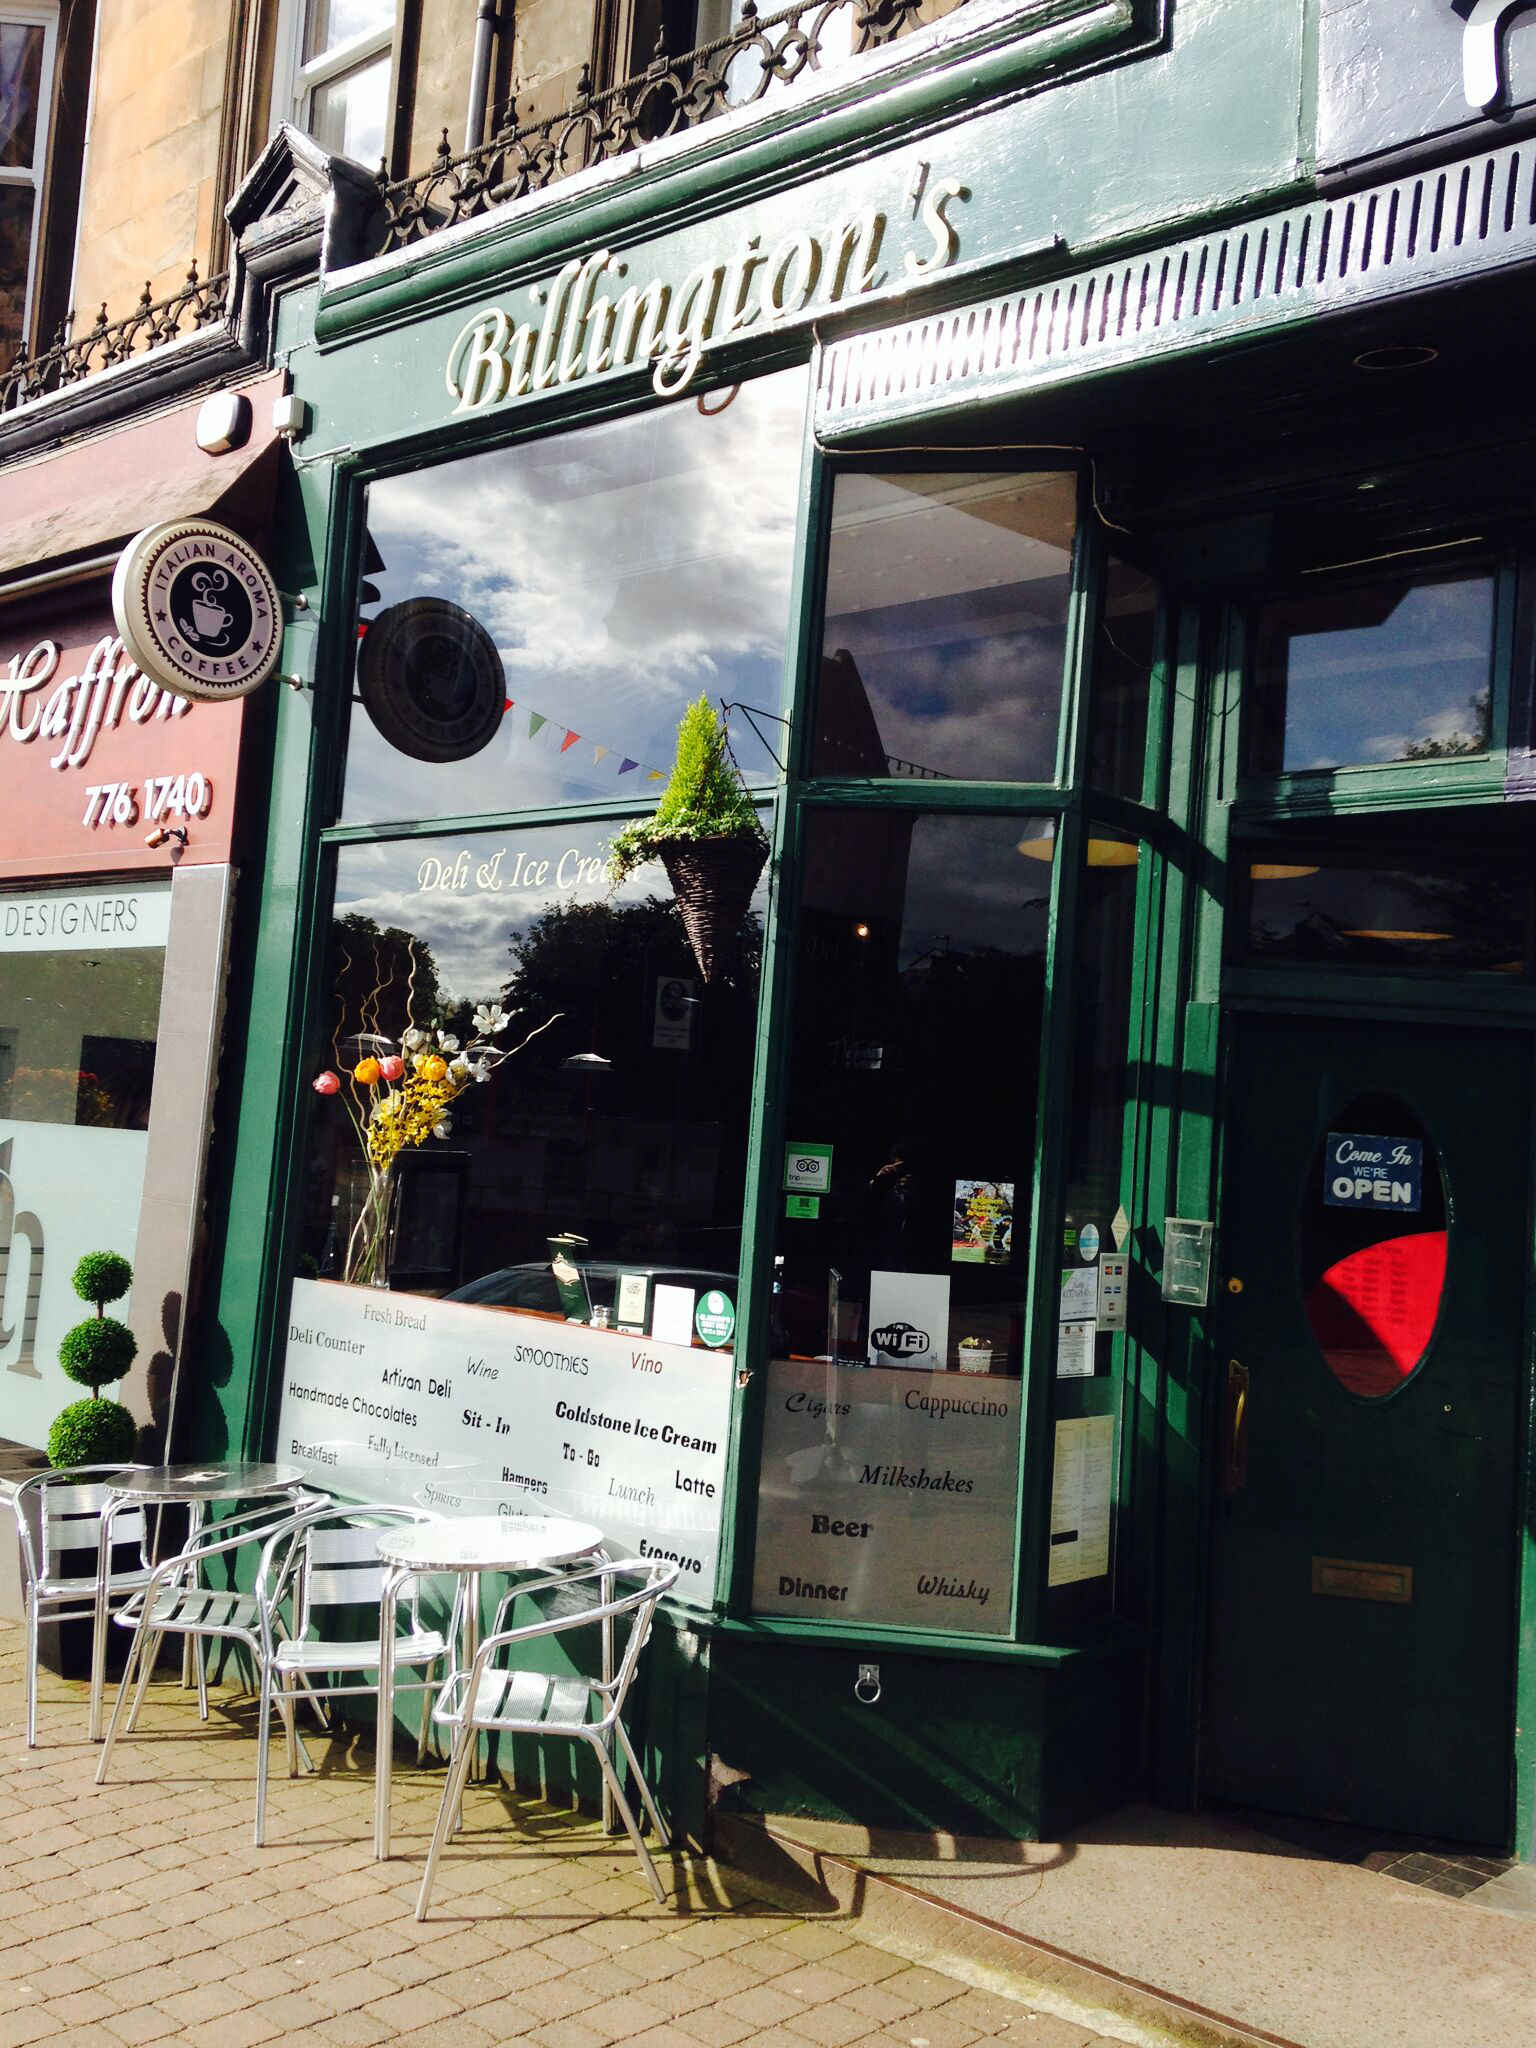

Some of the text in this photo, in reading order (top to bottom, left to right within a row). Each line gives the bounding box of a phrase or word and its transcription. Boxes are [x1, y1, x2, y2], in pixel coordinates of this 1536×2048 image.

[444, 163, 966, 416] Billington's
[155, 543, 268, 619] ITALIAN AROMA
[167, 636, 249, 676] COFFEE
[82, 772, 207, 826] 776 1740
[417, 850, 472, 892] Deli
[476, 848, 507, 891] &
[509, 852, 550, 888] Ice
[5, 898, 138, 936] DESIGNERS
[1335, 1140, 1414, 1166] Come In
[1353, 1166, 1389, 1179] WE'RE
[1331, 1176, 1413, 1205] OPEN
[363, 1304, 427, 1332] Fresh Bread
[289, 1325, 366, 1356] Deli Counter
[466, 1356, 500, 1380] Wine
[631, 1351, 663, 1375] Vino
[381, 1368, 452, 1399] Artisan Deli
[289, 1381, 418, 1427] Handmade Chocolates
[904, 1390, 1008, 1420] Cappuccino
[462, 1408, 483, 1429] Sit
[494, 1416, 511, 1436] In
[555, 1400, 718, 1455] Coldstone Ice Cream
[291, 1439, 339, 1466] Breakfast
[367, 1434, 440, 1468] Fully Licensed
[563, 1442, 576, 1461] To
[587, 1448, 601, 1468] Go
[502, 1466, 549, 1495] Hampers
[607, 1477, 656, 1507] Lunch
[675, 1469, 716, 1498] Latte
[859, 1464, 974, 1494] Milkshakes
[810, 1514, 874, 1538] Beer
[778, 1575, 849, 1601] Dinner
[917, 1574, 990, 1606] Whisky
